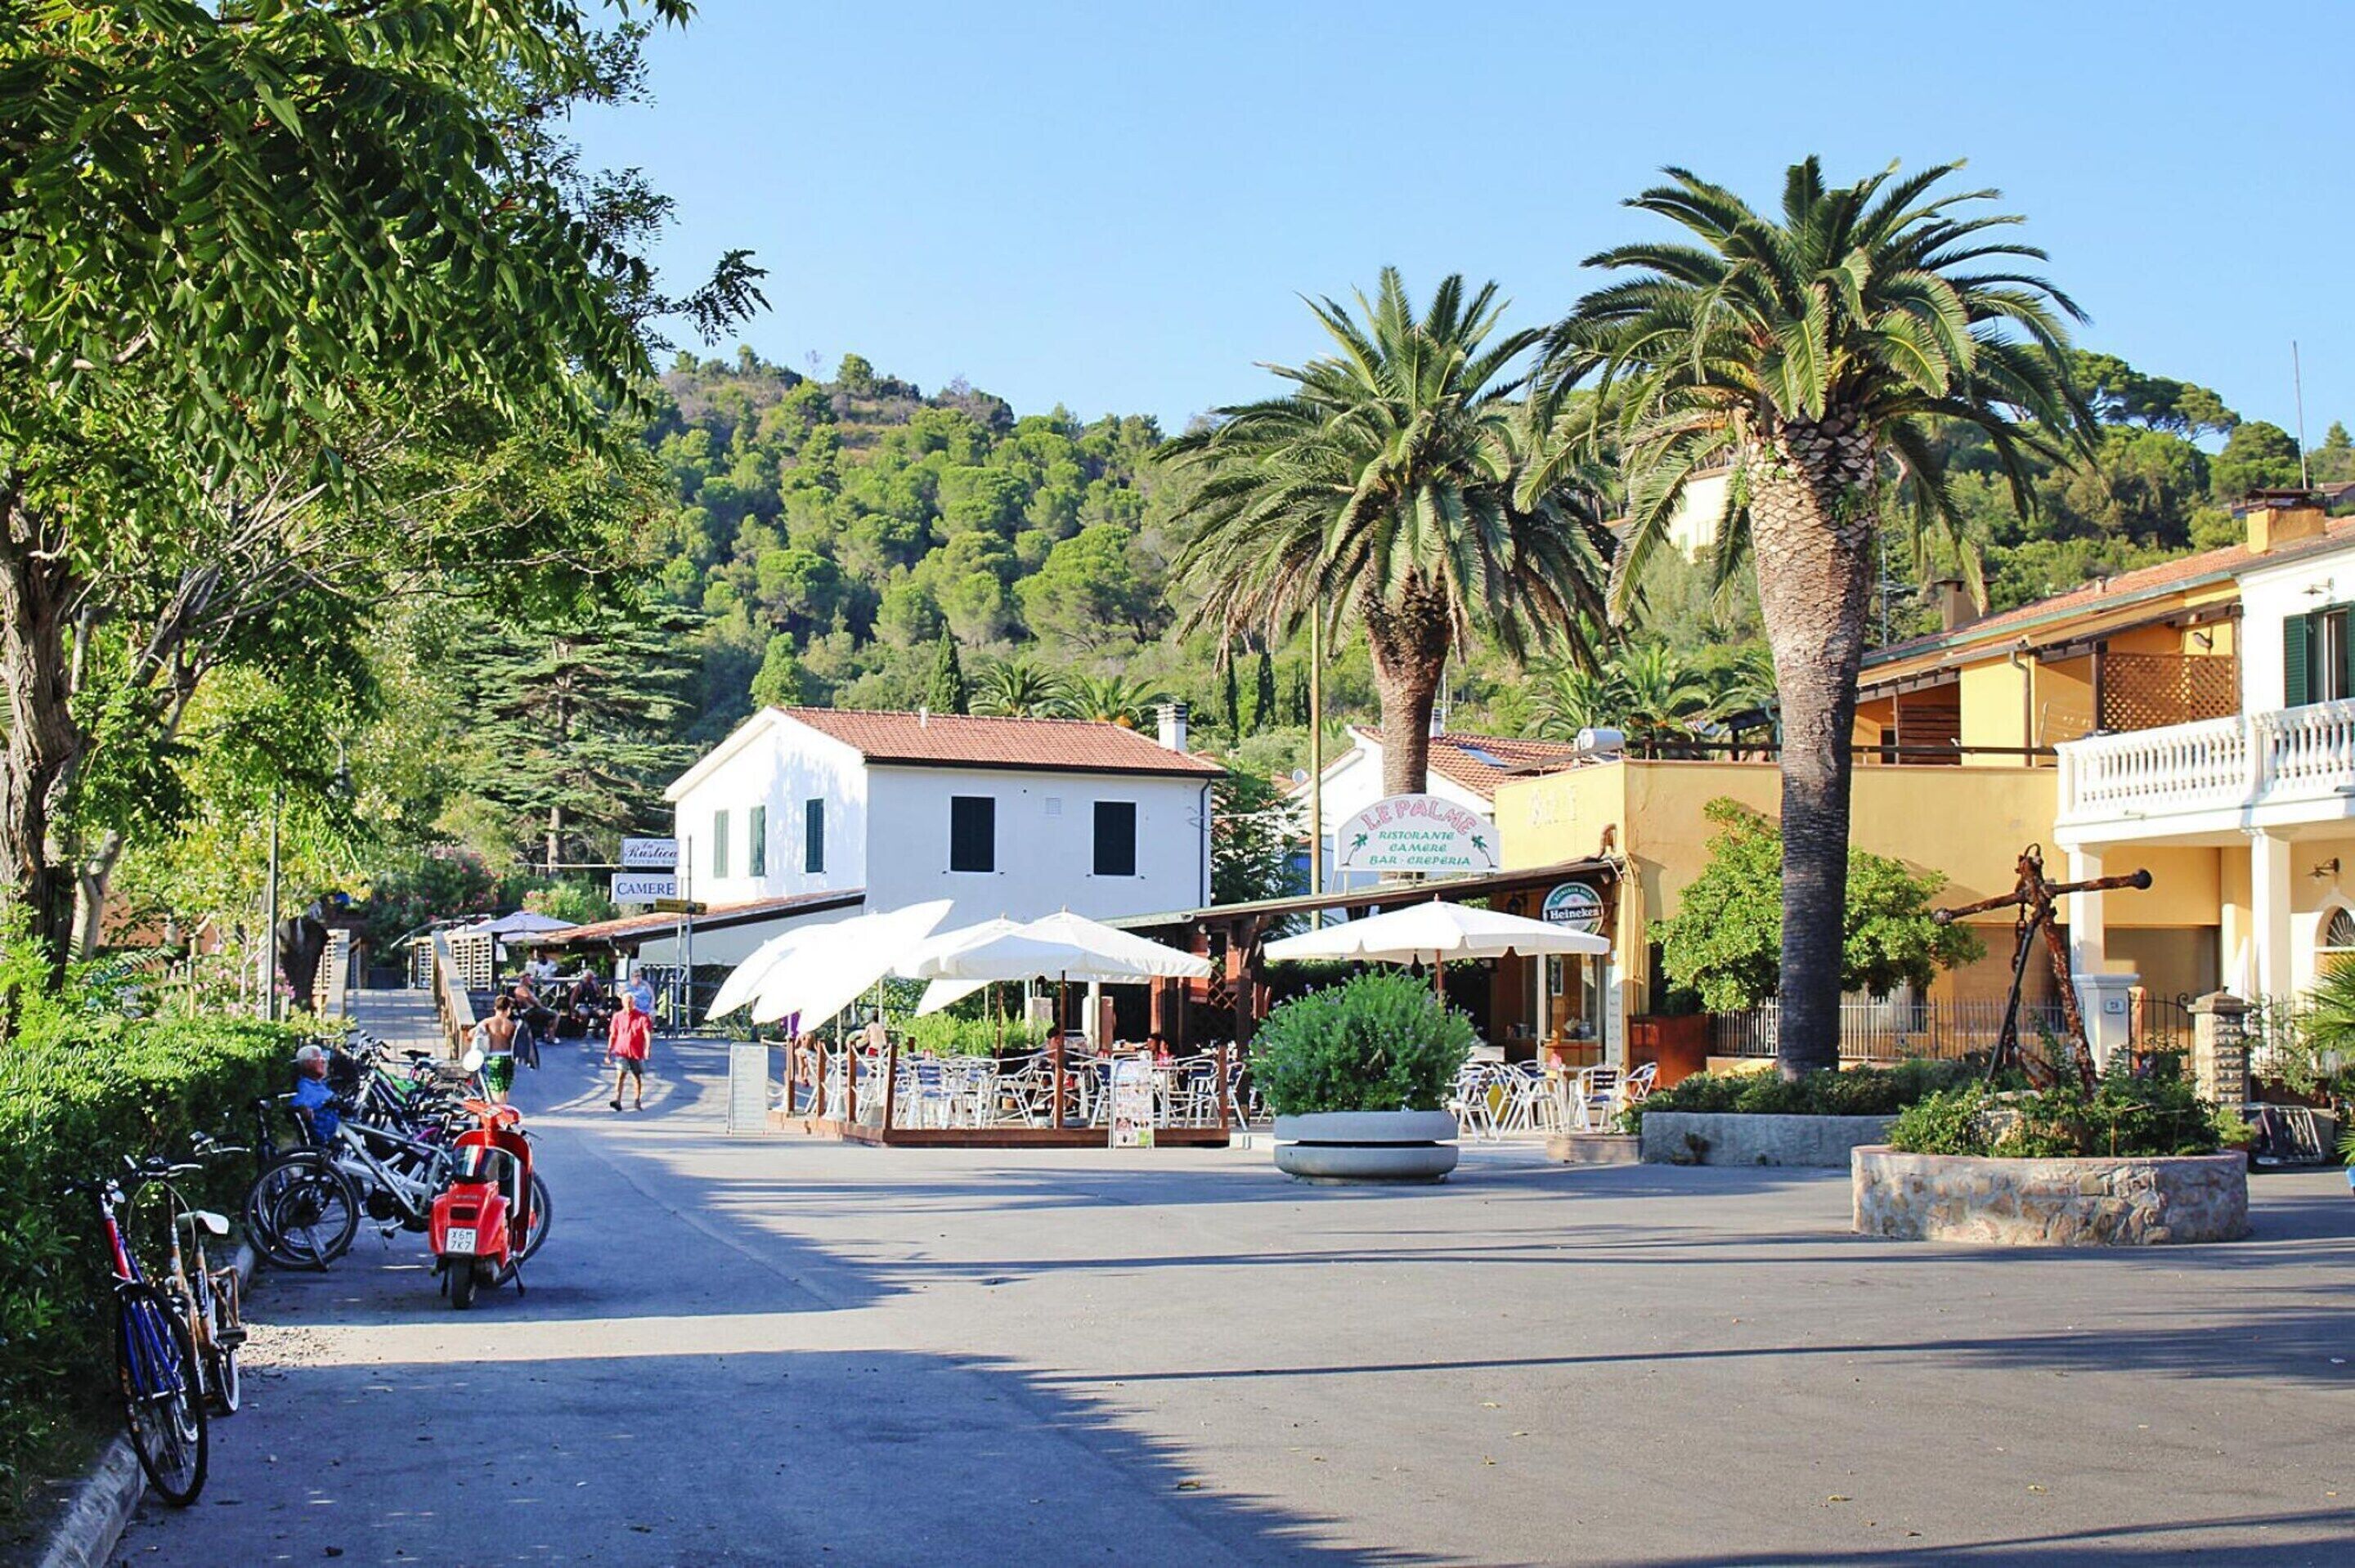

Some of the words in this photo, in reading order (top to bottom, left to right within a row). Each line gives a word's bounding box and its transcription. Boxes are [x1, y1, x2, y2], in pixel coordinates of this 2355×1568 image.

[1361, 804, 1393, 831] LE
[1394, 799, 1478, 836] PALME
[1378, 830, 1456, 840] RISTORANTE
[624, 845, 678, 858] Rustica
[1388, 843, 1448, 853] CAMERE
[1369, 855, 1397, 865] BAR
[1406, 856, 1471, 866] CREPERIA
[617, 882, 677, 896] CAMERE
[1549, 907, 1600, 921] Heineken
